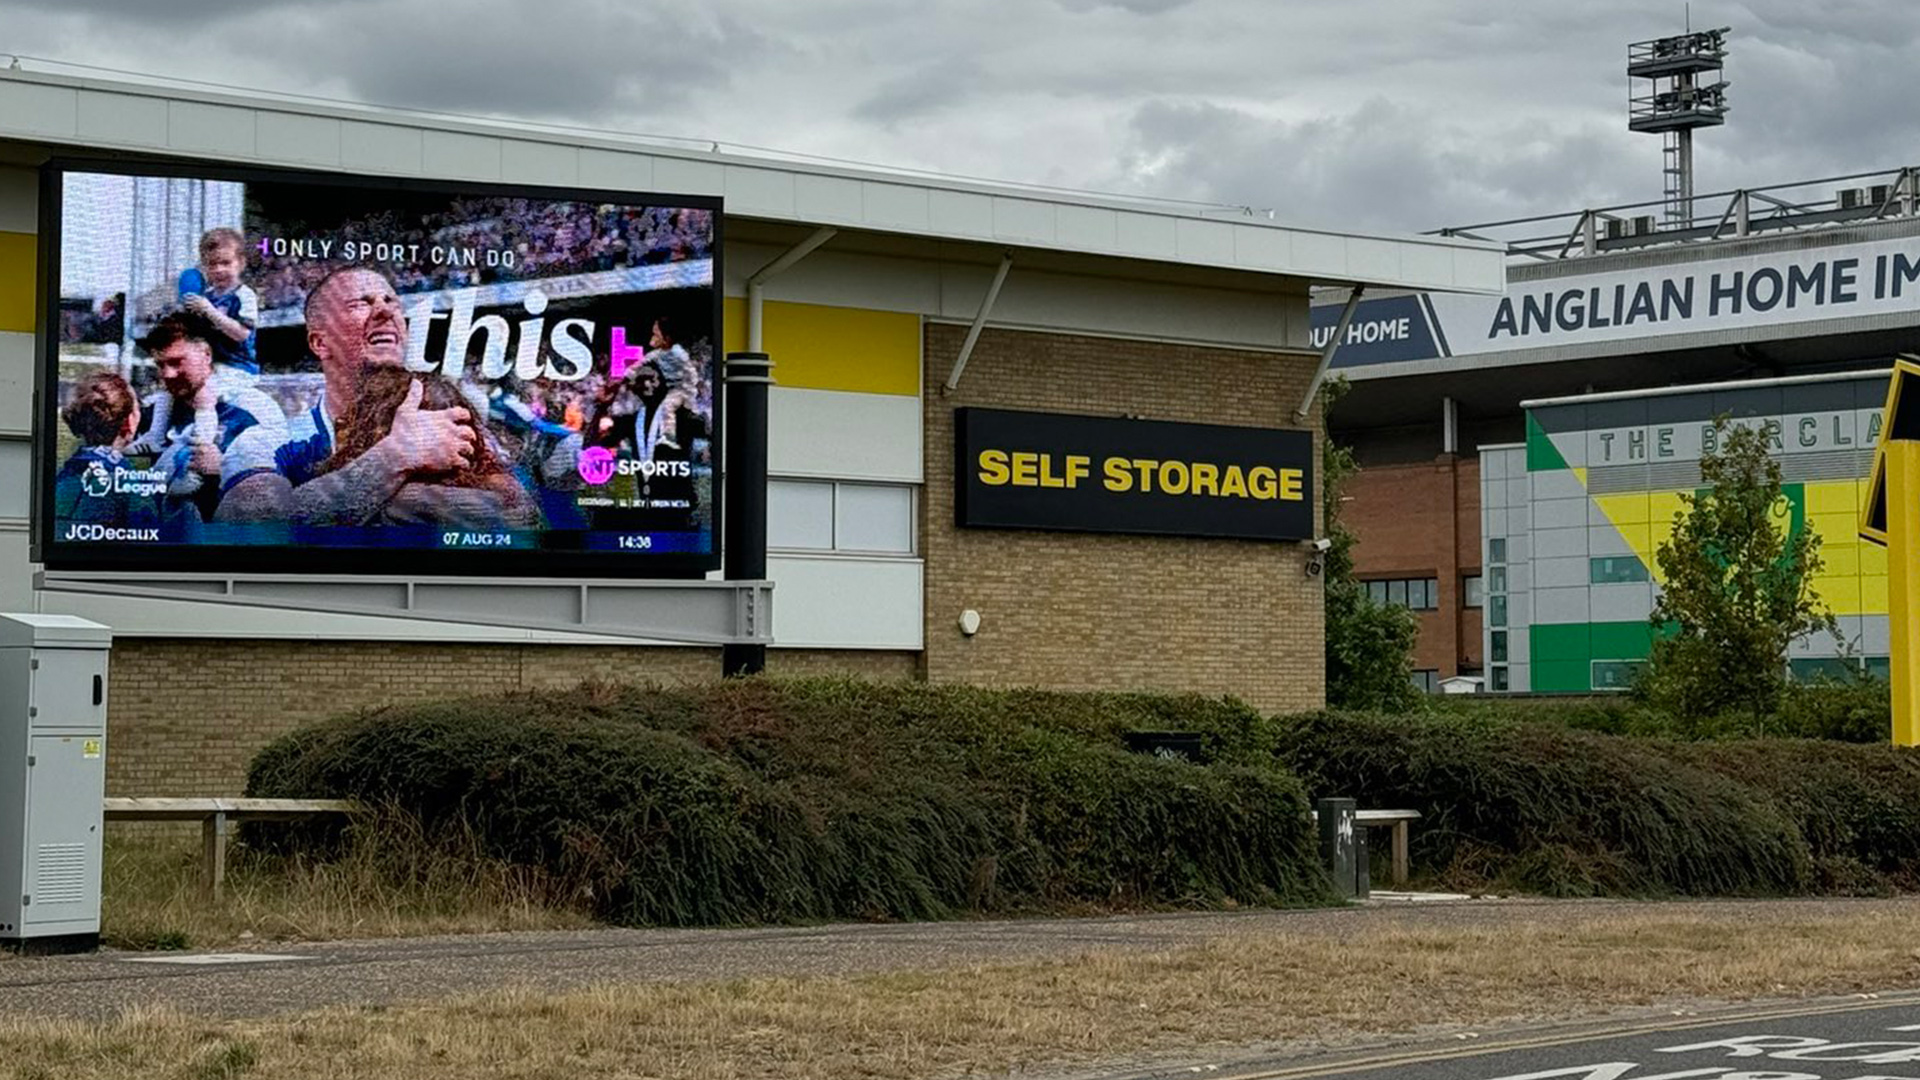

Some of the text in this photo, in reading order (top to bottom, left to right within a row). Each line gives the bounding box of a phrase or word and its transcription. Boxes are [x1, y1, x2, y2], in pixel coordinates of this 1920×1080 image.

[273, 238, 514, 268] ONLY SPORT CAN DO
[1488, 276, 1694, 340] ANGLIAN
[1709, 257, 1859, 317] HOME
[404, 284, 596, 382] this
[1346, 317, 1410, 345] HOME
[1600, 412, 1884, 461] THE BRCLA
[114, 466, 168, 480] Premier
[618, 460, 691, 477] SPORTS
[978, 449, 1304, 501] SELF STORAGE
[114, 482, 168, 496] League
[65, 524, 160, 541] JCDecaux
[443, 532, 511, 546] 07 AUG 24
